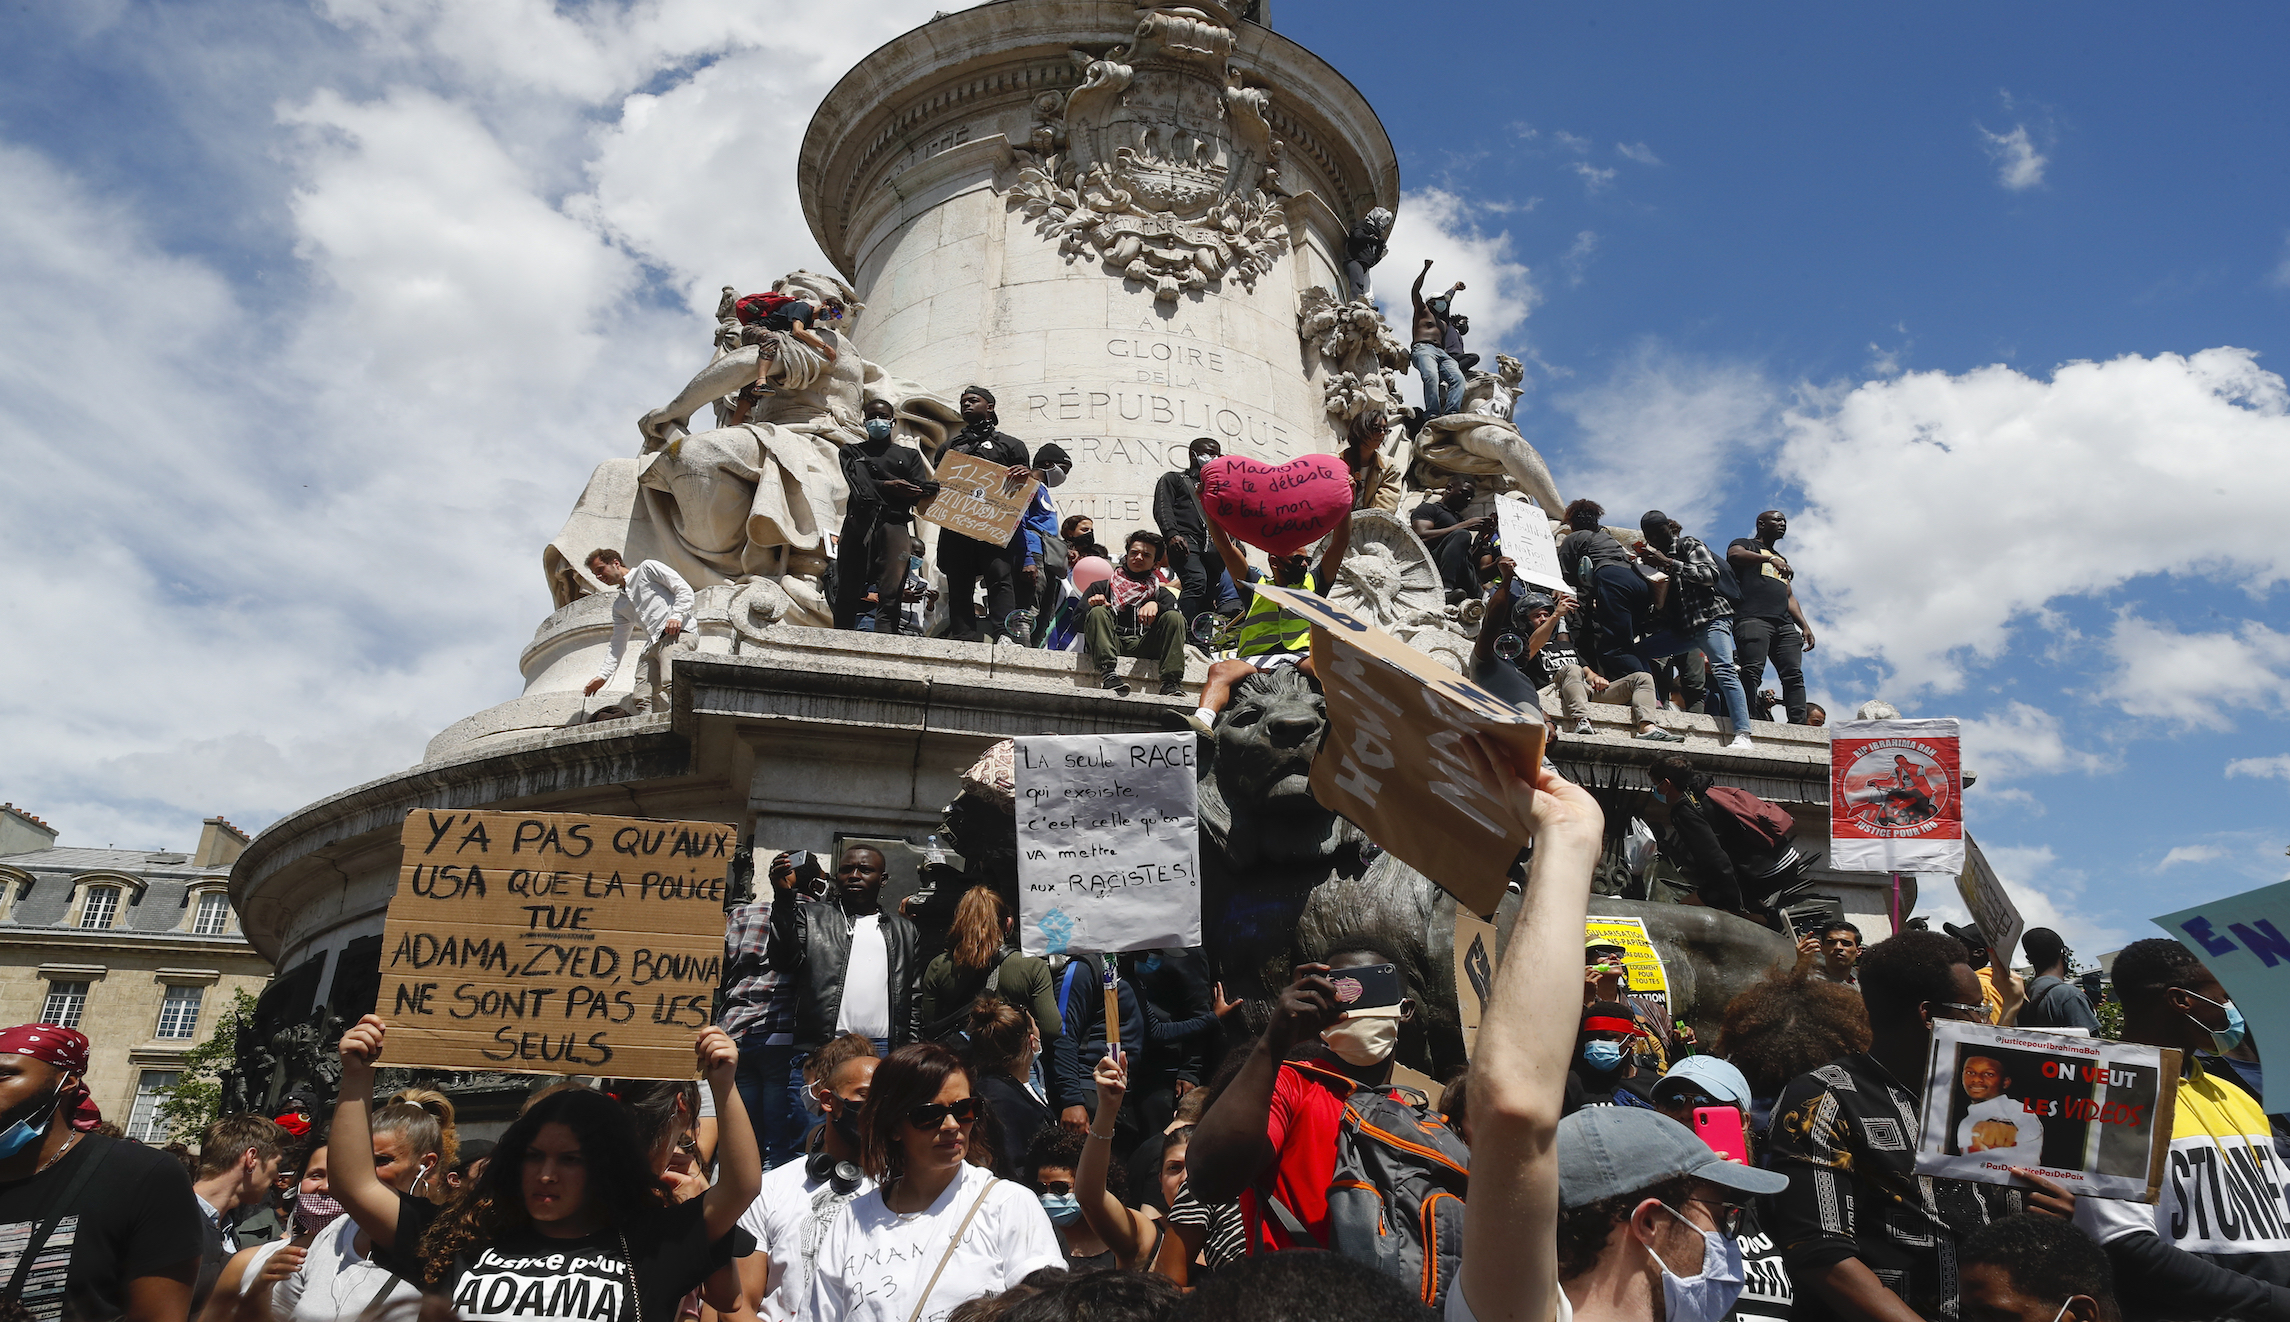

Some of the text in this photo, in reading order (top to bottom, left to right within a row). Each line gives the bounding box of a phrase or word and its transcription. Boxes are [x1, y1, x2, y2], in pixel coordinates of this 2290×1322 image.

[1166, 319, 1197, 337] LA
[1107, 338, 1224, 373] GLOIRE
[1137, 370, 1200, 390] DE LA
[1026, 386, 1291, 458] RÉPUBLIQUE
[948, 464, 996, 490] ILS
[1212, 464, 1339, 495] je te déteste
[1227, 459, 1310, 475] Macron
[1055, 500, 1142, 522] VILLE
[1217, 499, 1314, 518] de tout mon
[1024, 744, 1194, 770] LA seule RACE
[1853, 738, 1938, 759] RIP IBRAHIMA BAH
[1026, 785, 1050, 807] qui
[424, 812, 730, 858] Y'A PAS QU'AUX
[1028, 810, 1180, 837] c'est celle qu'on
[1854, 820, 1939, 838] JUSTICE POUR IBO
[1026, 843, 1118, 861] VA mettre
[412, 862, 487, 900] USA
[508, 868, 570, 899] QUE
[584, 870, 626, 899] LA
[520, 905, 596, 931] TUE
[1584, 928, 1645, 940] GULARISATION
[1608, 938, 1650, 948] NS-PAPIERS
[631, 948, 721, 986] BOUNA
[394, 982, 713, 1029] NE SONT PAS LES
[481, 1025, 614, 1067] SEULS
[1995, 1035, 2101, 1056] @justicepourIbrahimaBah
[2042, 1061, 2137, 1089] ON VEUT
[2022, 1097, 2059, 1117] LES
[2170, 1145, 2290, 1242] STUNNE
[473, 1247, 565, 1271] Justice
[454, 1276, 616, 1322] ADAMA
